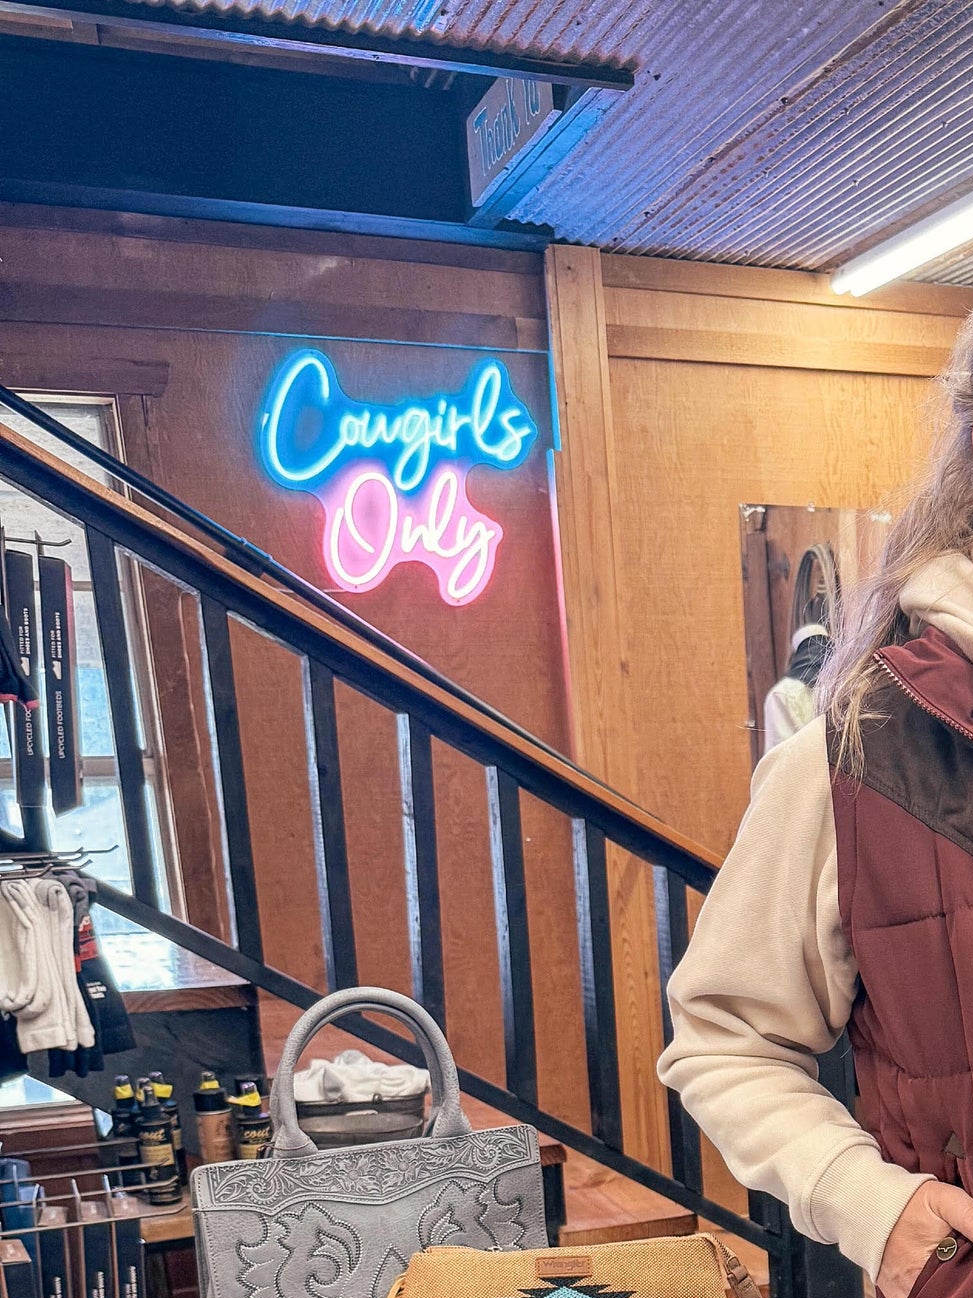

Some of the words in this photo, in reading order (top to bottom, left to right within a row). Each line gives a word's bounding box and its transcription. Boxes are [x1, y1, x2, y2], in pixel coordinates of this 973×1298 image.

[472, 77, 521, 177] Thank
[267, 356, 531, 491] Cowgirls
[330, 471, 496, 599] Only
[542, 1259, 586, 1271] Wrangler
